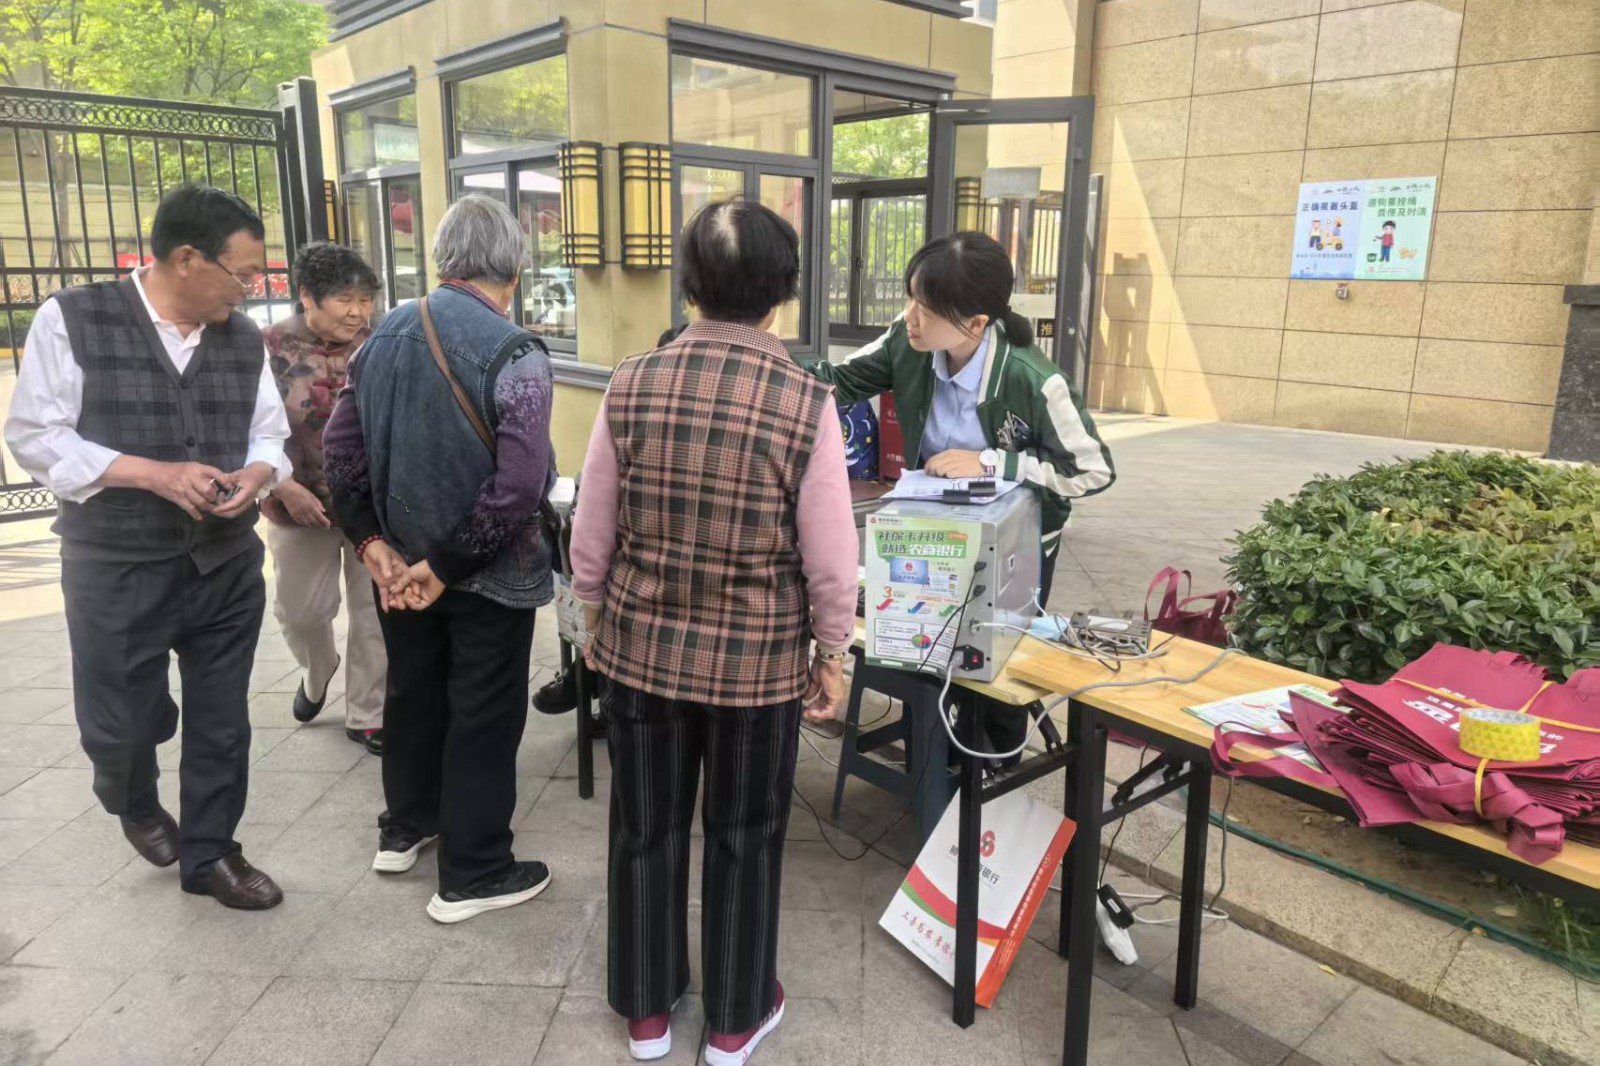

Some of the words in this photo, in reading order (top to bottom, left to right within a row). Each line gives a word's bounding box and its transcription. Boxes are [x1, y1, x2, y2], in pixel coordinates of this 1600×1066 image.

[1301, 201, 1359, 211] 正确佩戴头盔
[1377, 207, 1427, 217] 粪便及时清
[1040, 322, 1054, 336] 推
[878, 530, 945, 542] 社保卡升级
[883, 586, 893, 598] 3
